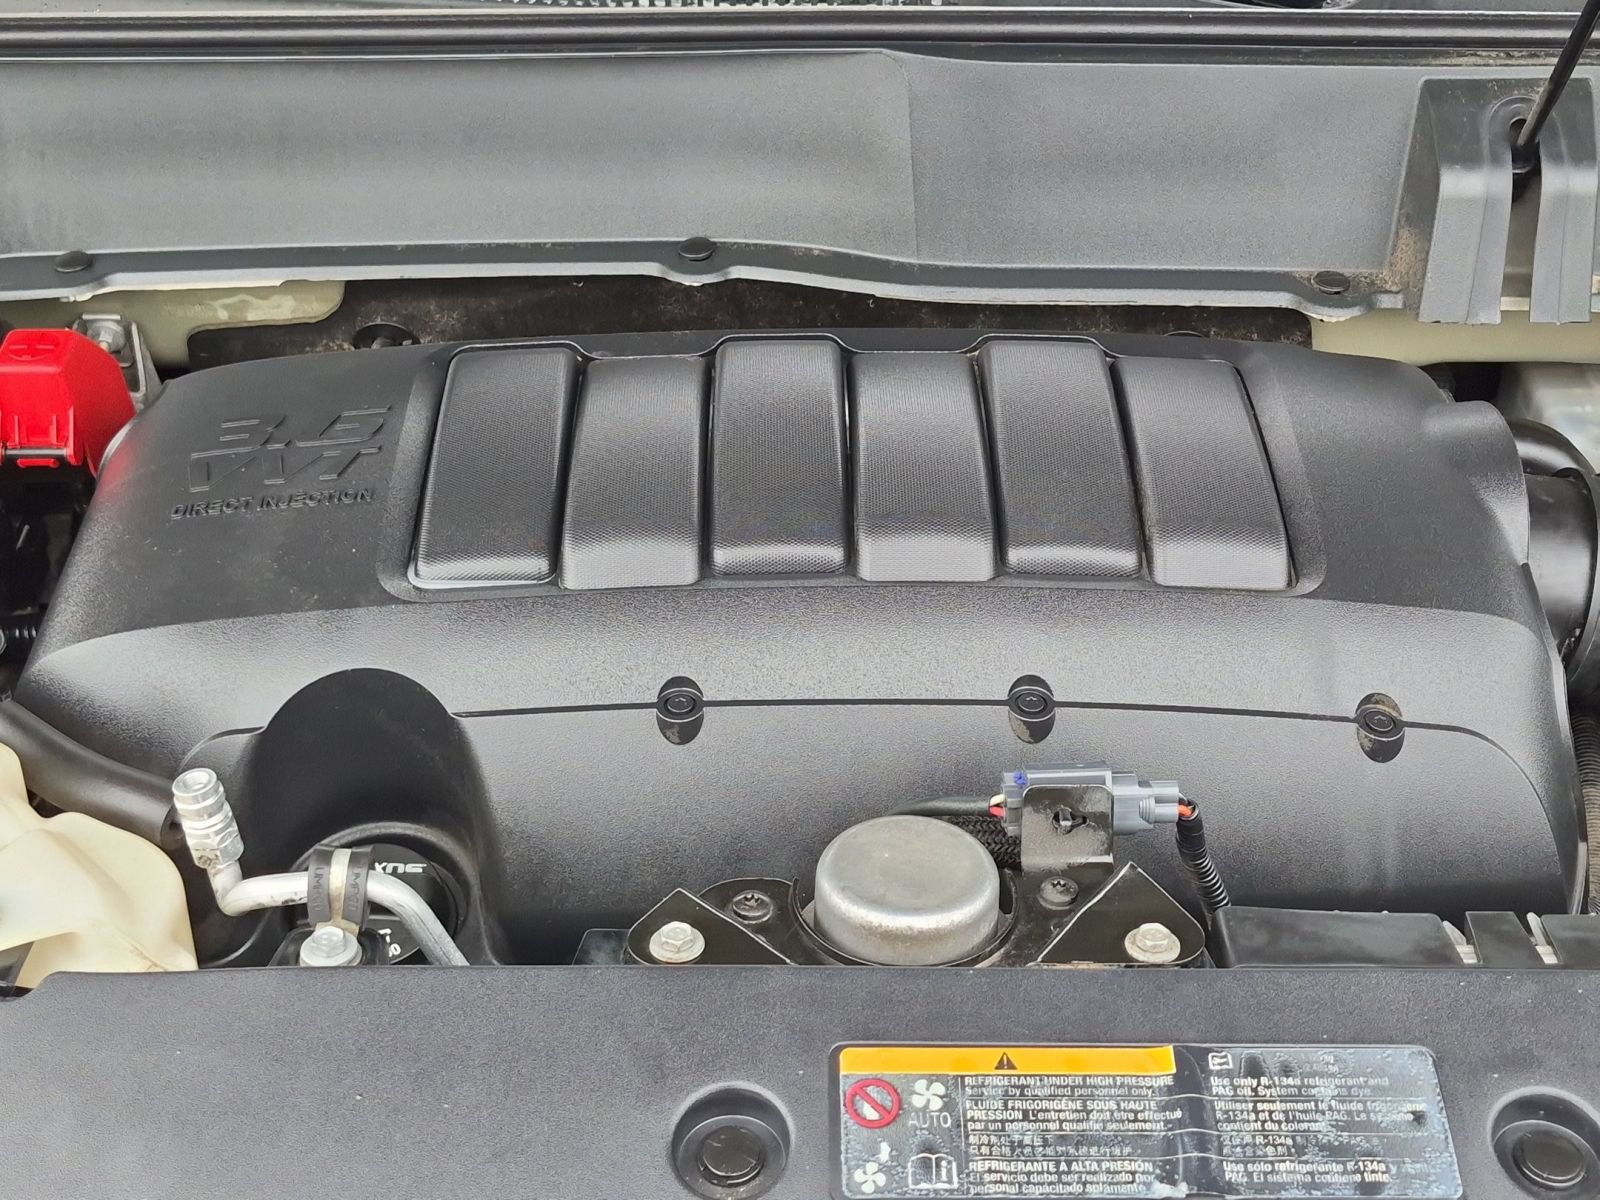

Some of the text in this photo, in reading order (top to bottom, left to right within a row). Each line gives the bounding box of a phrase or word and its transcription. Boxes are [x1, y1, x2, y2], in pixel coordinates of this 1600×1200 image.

[171, 488, 375, 520] DIRECT INJECTION
[965, 1076, 1175, 1086] REFRIGERANT UNDER HIGH PRESSURE
[1211, 1077, 1230, 1087] Use
[1233, 1076, 1257, 1088] only
[1260, 1077, 1300, 1087] R-134a
[1008, 1086, 1021, 1097] by
[1024, 1086, 1071, 1097] qualified
[1074, 1086, 1128, 1097] personnel
[1212, 1086, 1233, 1096] PAG
[1257, 1086, 1298, 1098] System
[966, 1100, 1005, 1110] FLUIDE
[1087, 1100, 1117, 1110] SOUS
[1120, 1100, 1158, 1110] HAUTE
[1214, 1101, 1254, 1111] Utiliser
[1256, 1101, 1315, 1111] seulement
[1331, 1101, 1363, 1111] fluide
[909, 1111, 952, 1128] AUTO
[1089, 1110, 1110, 1120] doit
[1216, 1111, 1256, 1121] R-134a
[1259, 1111, 1269, 1121] et
[1271, 1111, 1285, 1121] de
[1354, 1111, 1367, 1121] Le
[967, 1121, 985, 1132] par
[988, 1121, 1002, 1132] un
[1005, 1121, 1059, 1132] personnel
[1217, 1121, 1262, 1131] contient
[1264, 1121, 1279, 1131] du
[1255, 1136, 1293, 1146] R-134a
[969, 1161, 1056, 1172] REFRIGERANTE
[1071, 1161, 1099, 1172] ALTA
[1102, 1158, 1153, 1172] PRESIÓN
[1223, 1161, 1245, 1172] Use
[1248, 1160, 1271, 1172] sólo
[1274, 1161, 1344, 1174] refrigerante
[1347, 1161, 1386, 1172] R-134a
[983, 1173, 1027, 1184] servicio
[1030, 1173, 1058, 1184] debe
[1081, 1173, 1133, 1184] realizado
[1253, 1172, 1264, 1182] El
[1267, 1172, 1312, 1182] sistema
[1315, 1172, 1361, 1182] contiene
[971, 1183, 1019, 1195] personal
[1022, 1183, 1083, 1195] capacitado
